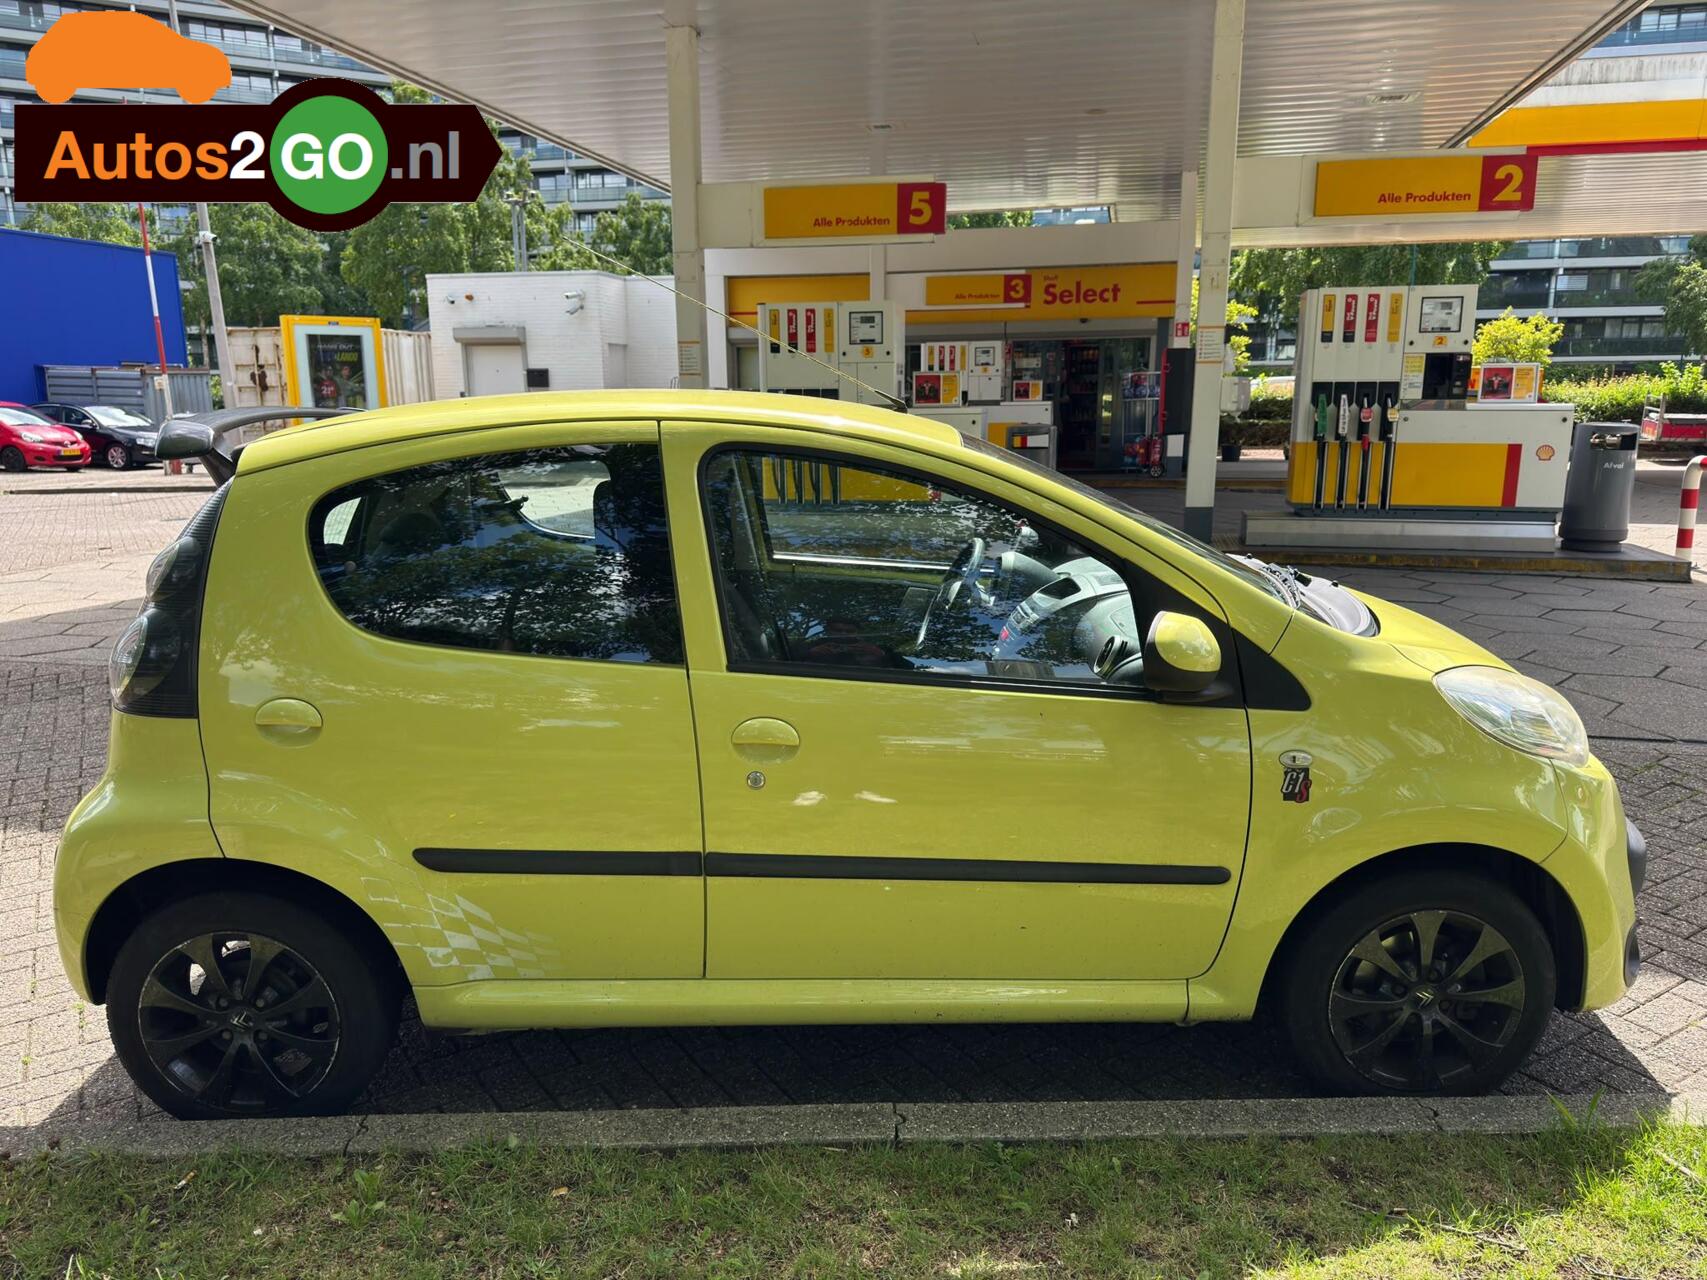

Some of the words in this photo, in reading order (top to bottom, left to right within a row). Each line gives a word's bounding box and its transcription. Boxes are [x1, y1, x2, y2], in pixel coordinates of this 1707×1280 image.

[1491, 163, 1524, 202] 2
[1377, 192, 1402, 204] Alle
[1404, 190, 1472, 203] Produkten
[908, 191, 933, 225] 5
[813, 217, 833, 227] Alle
[835, 216, 890, 227] Produkten
[1009, 278, 1025, 298] 3
[1043, 280, 1121, 305] Select
[1437, 336, 1444, 345] 2
[1603, 461, 1625, 469] Afval
